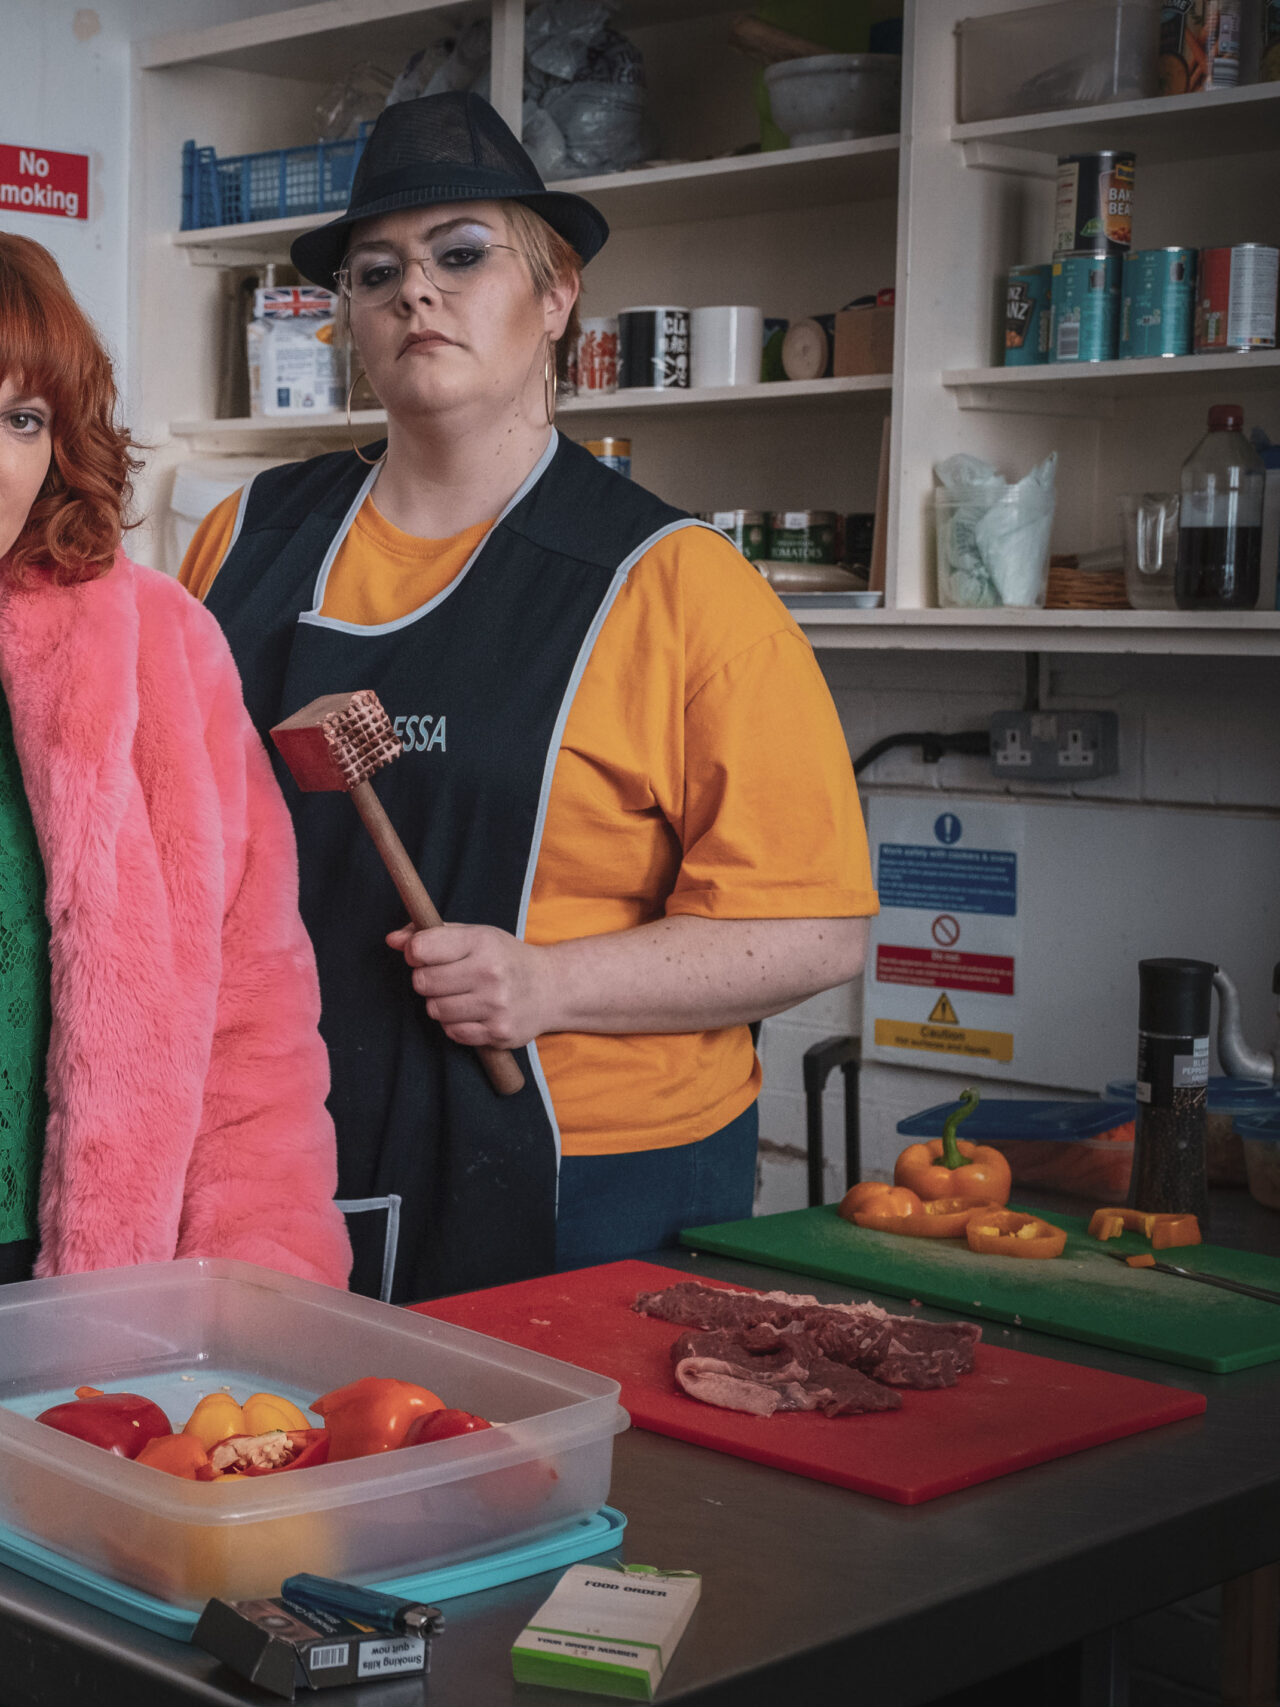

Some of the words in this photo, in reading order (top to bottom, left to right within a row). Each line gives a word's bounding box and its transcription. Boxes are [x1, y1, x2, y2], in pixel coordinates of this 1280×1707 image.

[19, 151, 49, 177] No
[920, 1025, 966, 1042] Caution
[585, 1580, 619, 1591] FOOD
[624, 1587, 667, 1597] ORDER
[372, 1647, 389, 1655] now
[392, 1643, 410, 1652] quit
[537, 1636, 562, 1646] YOUR
[564, 1642, 596, 1651] ORDER
[597, 1647, 639, 1658] NUMBER
[362, 1659, 380, 1671] kills
[384, 1654, 422, 1670] Smoking
